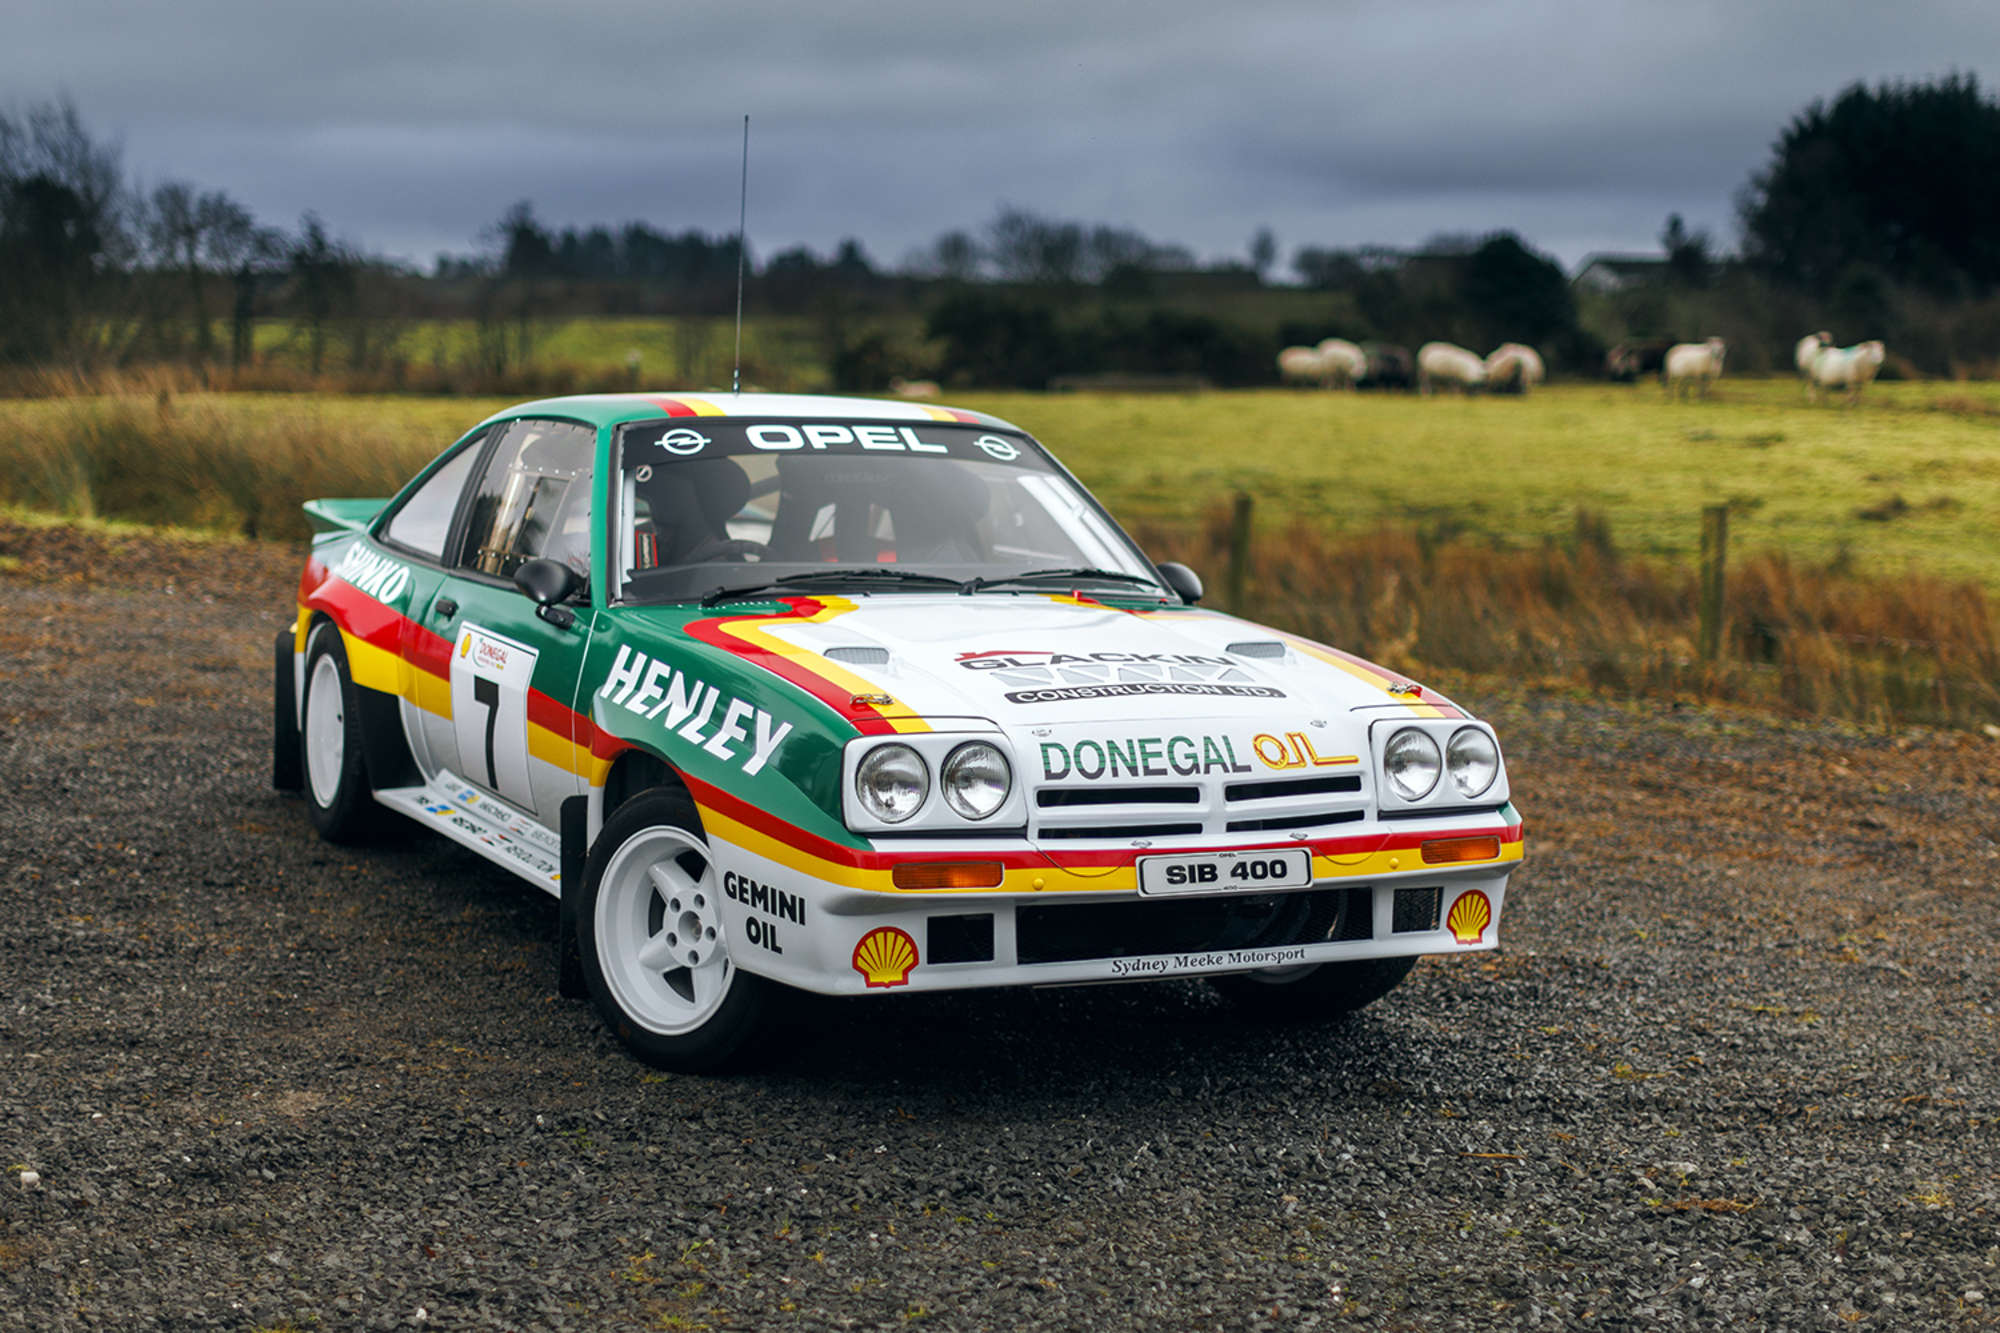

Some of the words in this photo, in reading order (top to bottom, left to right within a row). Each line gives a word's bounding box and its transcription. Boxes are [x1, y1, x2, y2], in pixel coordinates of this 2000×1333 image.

[745, 424, 948, 454] OPEL
[959, 652, 1238, 670] GLACKIN
[1016, 683, 1220, 703] CONSTRUCTION
[600, 644, 794, 776] HENLEY
[473, 674, 499, 792] 7
[1040, 735, 1252, 780] DONEGAL
[1253, 731, 1359, 770] OIL
[1166, 863, 1218, 885] SIB
[1230, 860, 1287, 881] 400
[723, 870, 806, 926] GEMINI
[745, 917, 783, 954] OIL
[1112, 958, 1169, 976] Sydney
[1173, 954, 1223, 969] Meeke
[1227, 948, 1305, 965] Motorsport
